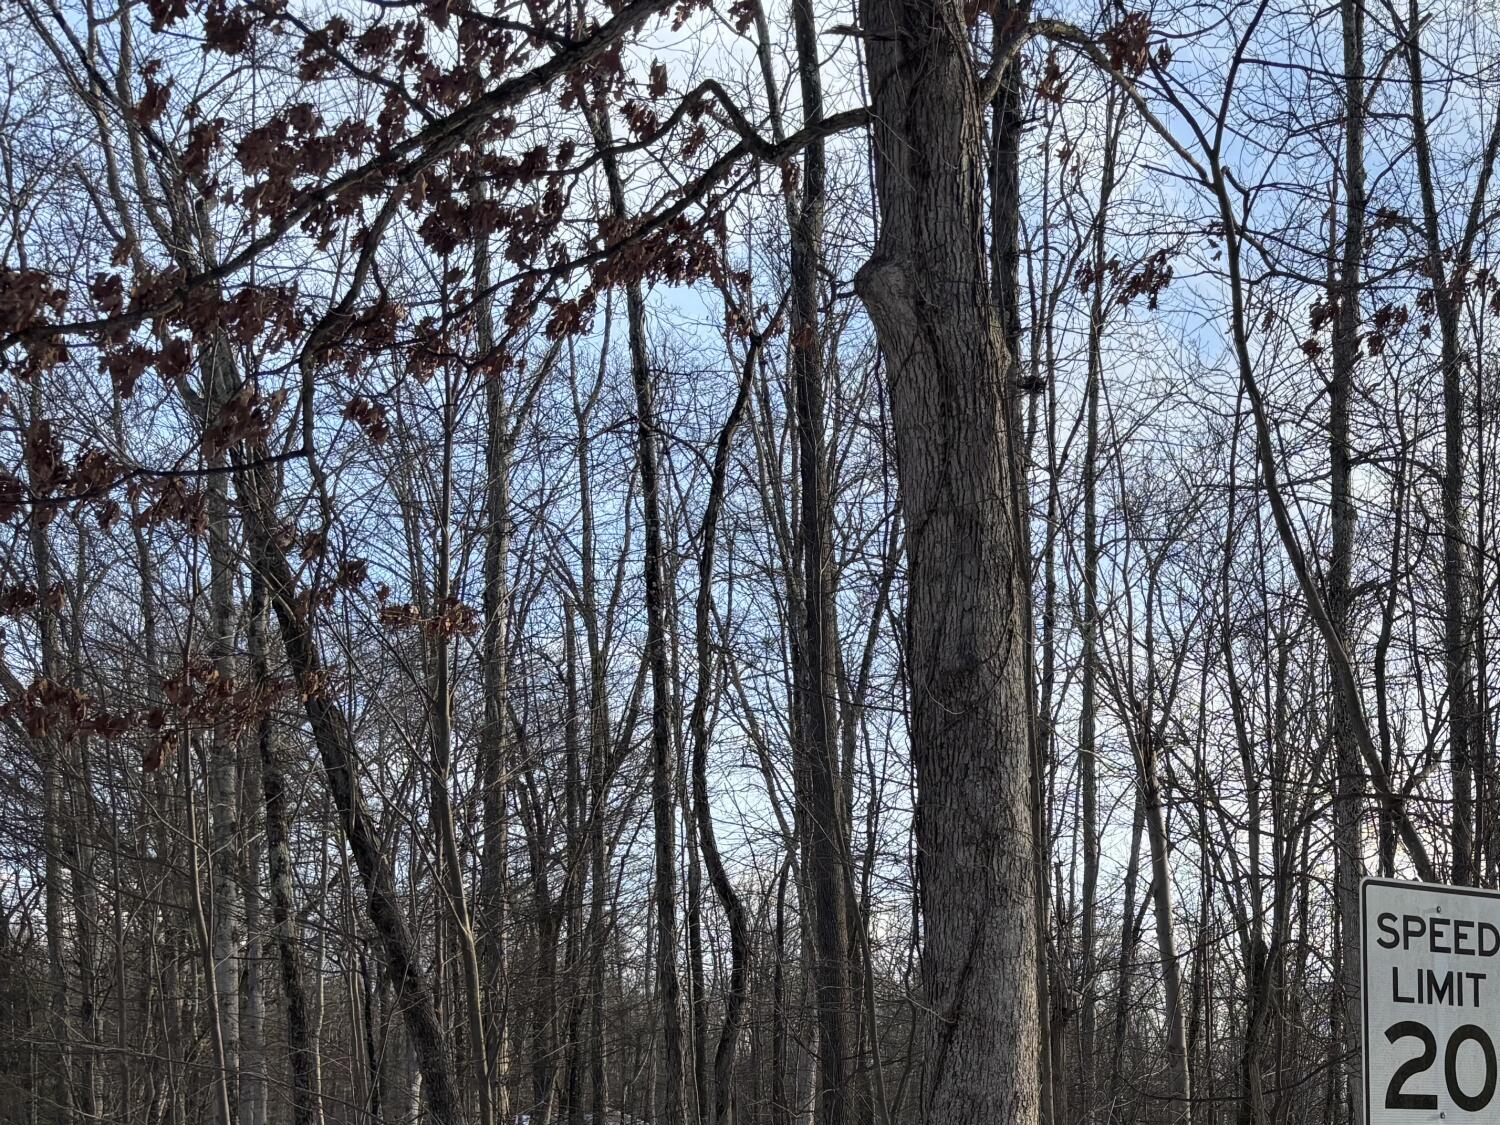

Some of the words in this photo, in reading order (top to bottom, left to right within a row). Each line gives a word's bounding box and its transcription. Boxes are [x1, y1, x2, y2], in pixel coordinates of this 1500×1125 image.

[1376, 912, 1500, 957] SPEED
[1392, 966, 1487, 1008] LIMIT
[1384, 1020, 1498, 1112] 20
